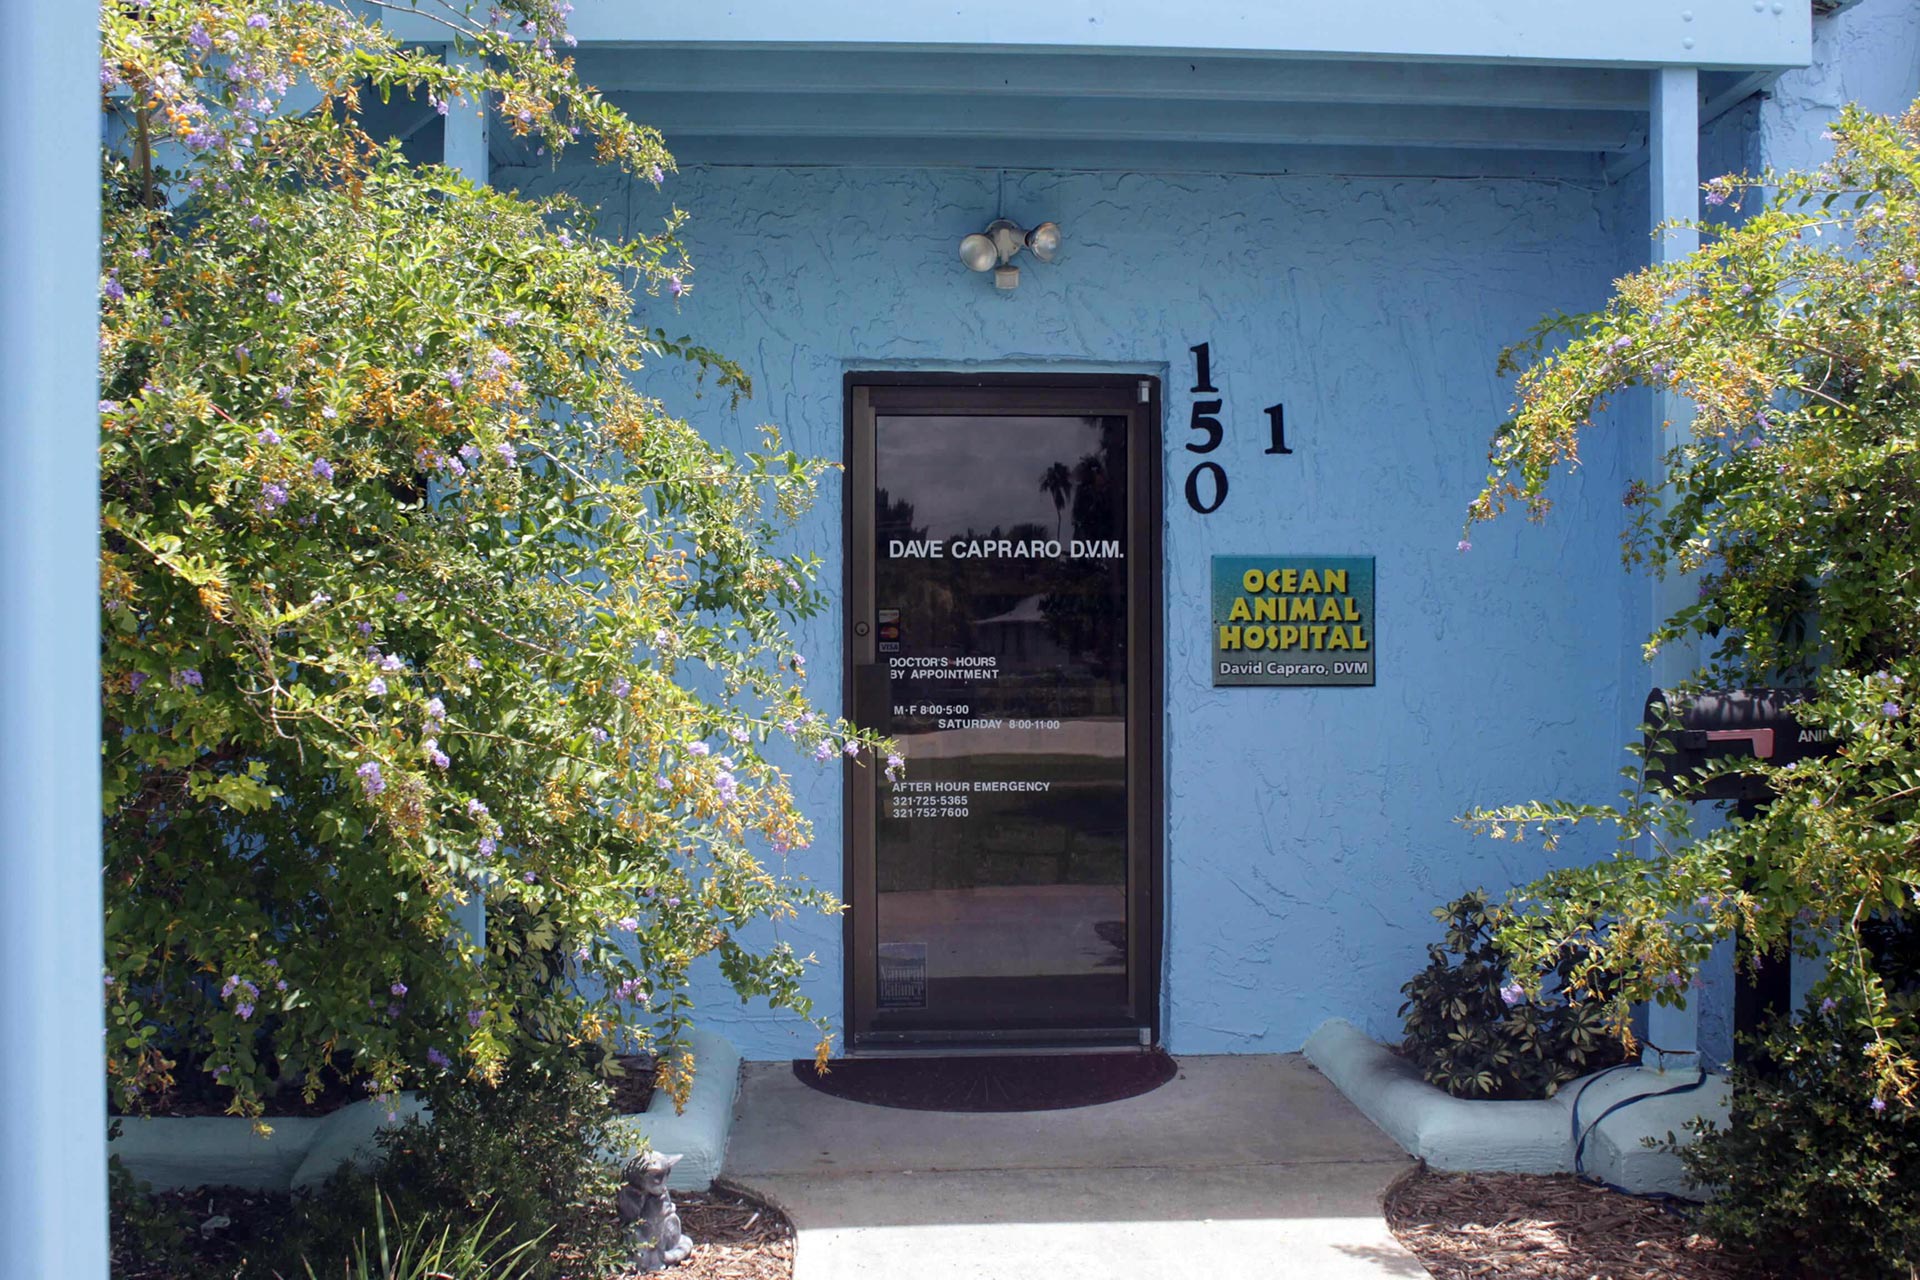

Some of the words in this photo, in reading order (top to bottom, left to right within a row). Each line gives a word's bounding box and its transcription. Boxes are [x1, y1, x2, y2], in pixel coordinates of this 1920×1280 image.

[889, 540, 944, 558] DAVE
[951, 540, 1062, 559] CAPRARO
[1069, 540, 1125, 558] D.V.M.
[1242, 568, 1347, 594] OCEAN
[1229, 596, 1360, 622] ANIMAL
[1219, 625, 1368, 651] HOSPITAL
[889, 657, 948, 668] DOCTOR'S
[956, 656, 996, 667] HOURS
[1219, 662, 1262, 675] David
[1266, 662, 1329, 677] Capraro,
[1333, 662, 1368, 674] DVM
[890, 669, 905, 680] BY
[910, 669, 1000, 680] APPOINTMENT
[938, 718, 1002, 730] SATURDAY
[892, 782, 932, 793] AFTER
[935, 782, 970, 792] HOUR
[974, 782, 1050, 792] EMERGENCY
